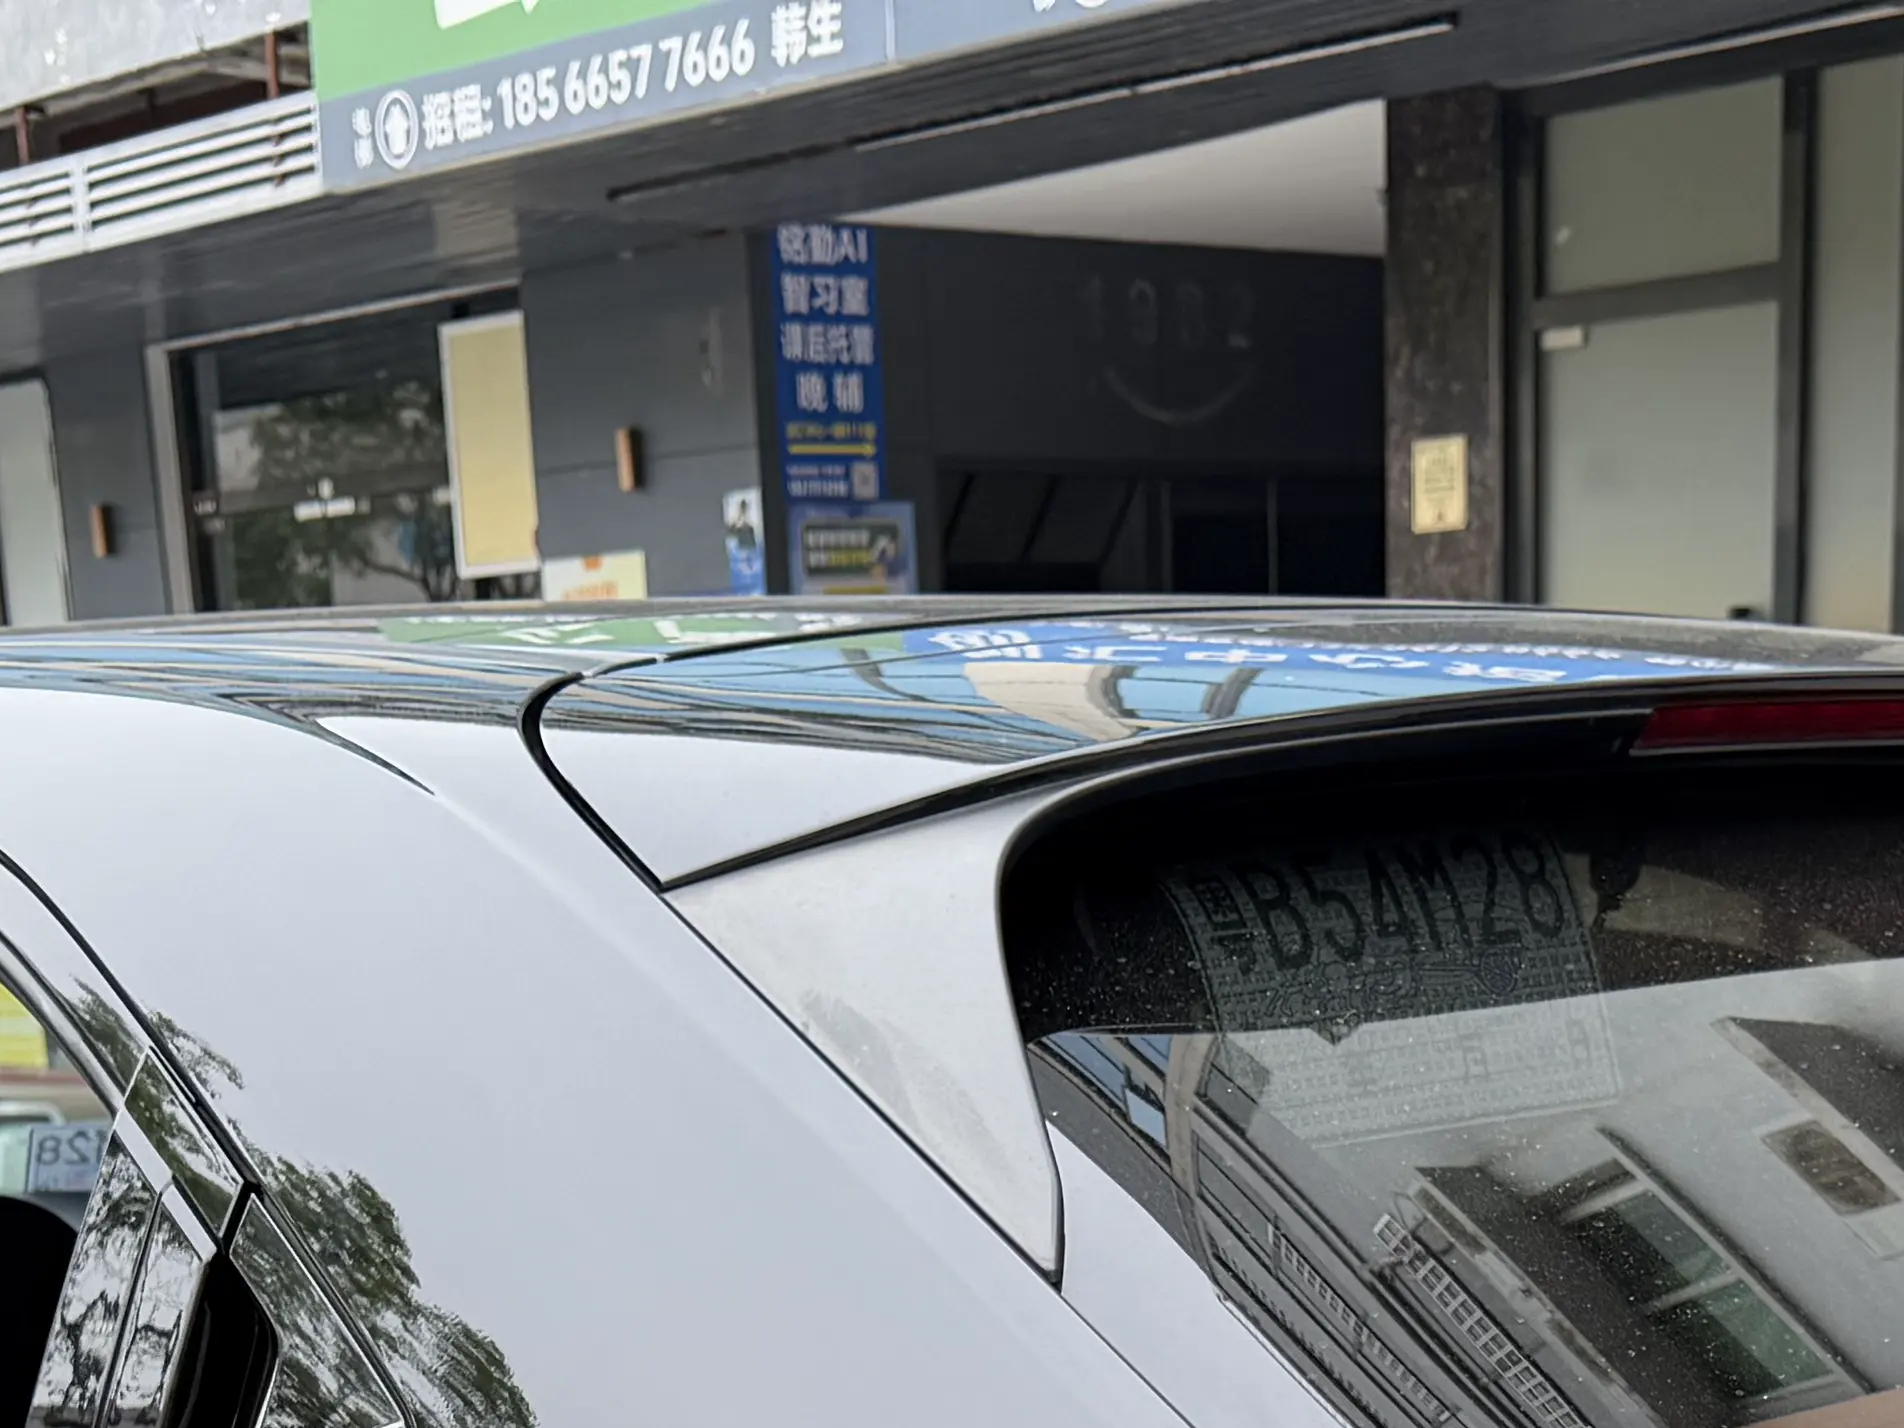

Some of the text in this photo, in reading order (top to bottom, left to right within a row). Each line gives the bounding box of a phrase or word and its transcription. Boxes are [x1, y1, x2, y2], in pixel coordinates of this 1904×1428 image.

[497, 65, 560, 130] 185
[563, 43, 653, 117] 6657
[662, 17, 757, 96] 7666
